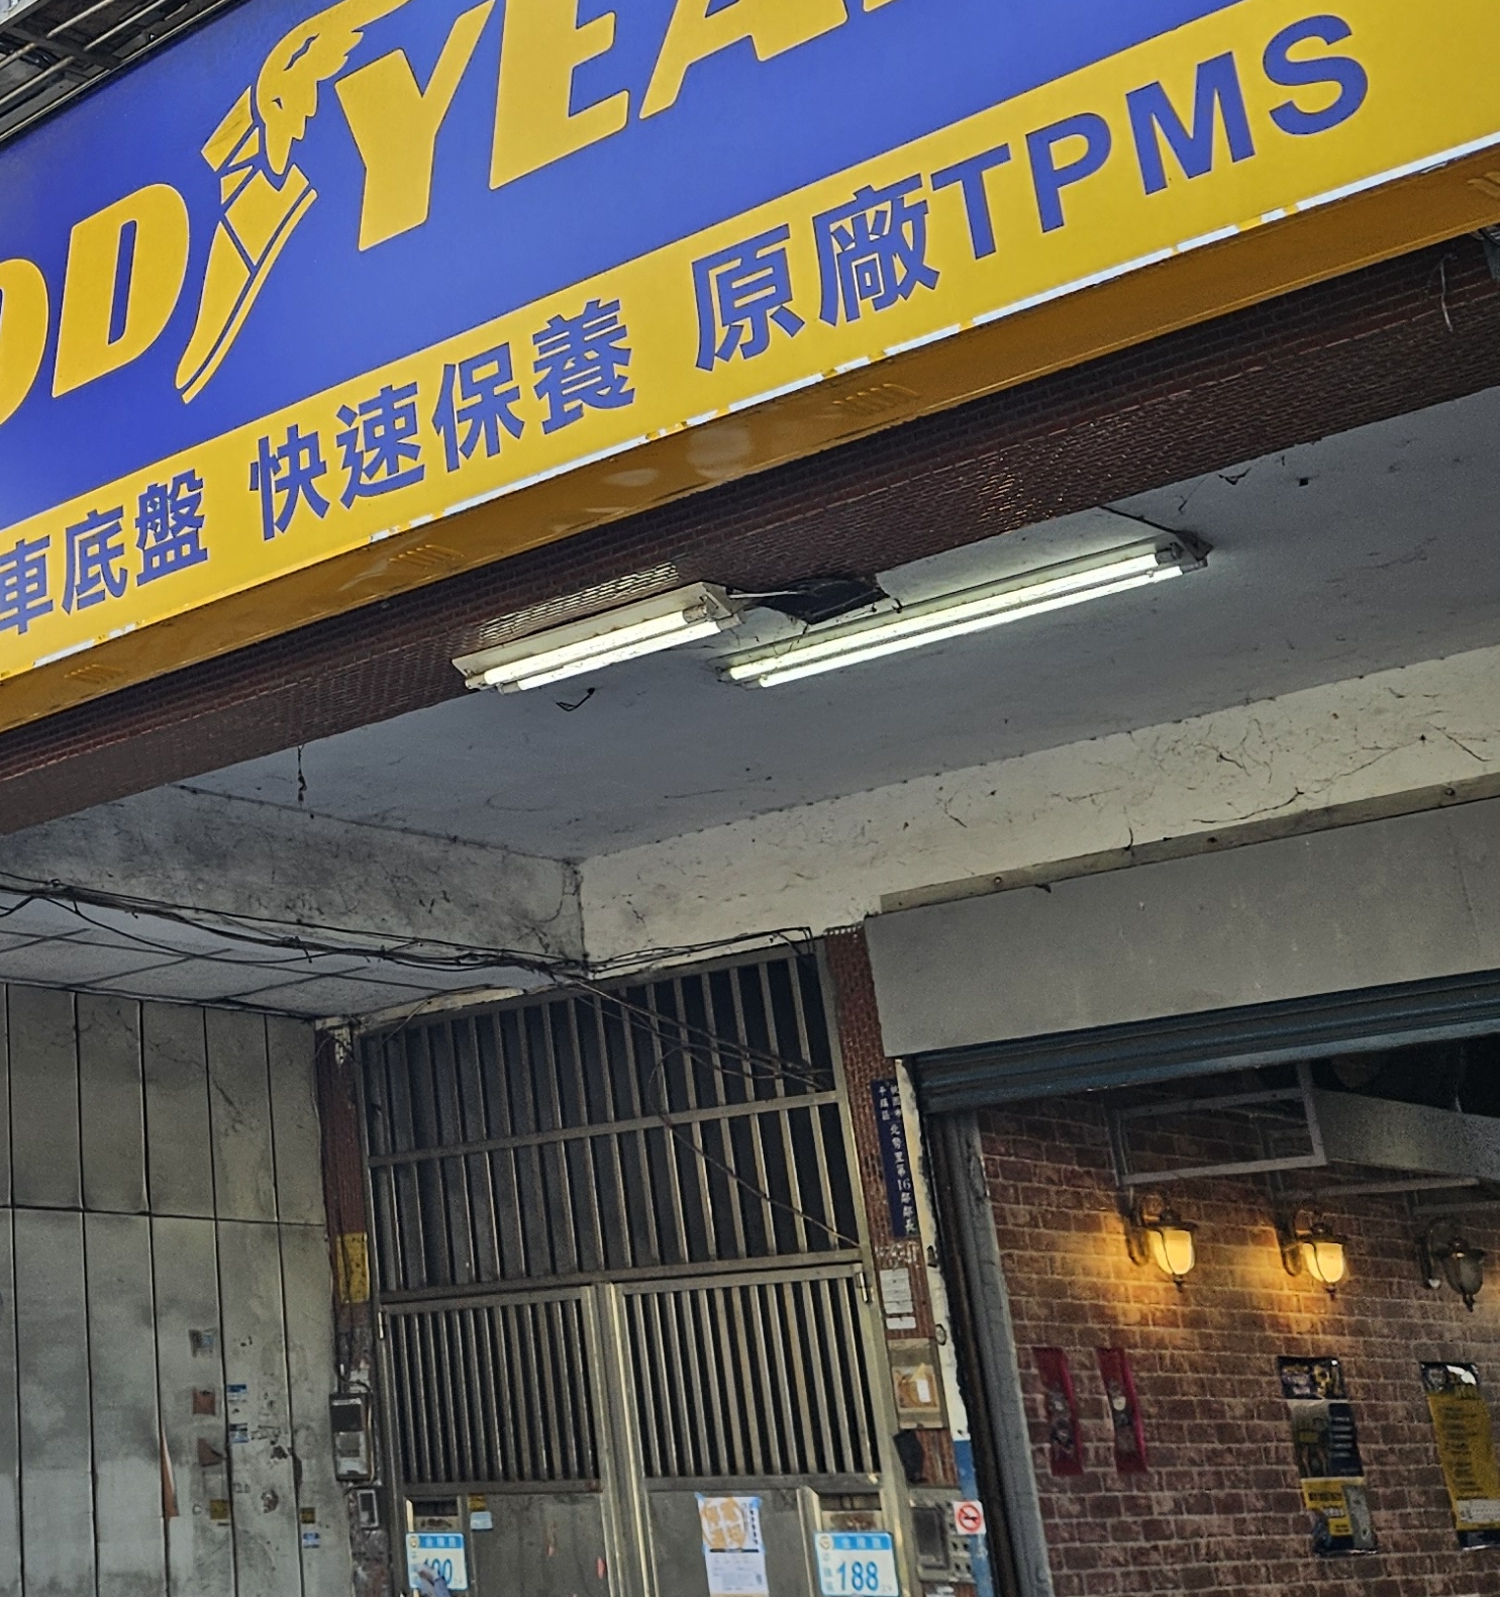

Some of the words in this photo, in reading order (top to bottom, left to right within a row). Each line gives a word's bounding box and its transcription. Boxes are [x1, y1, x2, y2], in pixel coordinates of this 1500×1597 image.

[250, 298, 636, 541] 快速保養
[691, 12, 1370, 372] 原廠TPMS
[836, 1560, 879, 1592] 188
